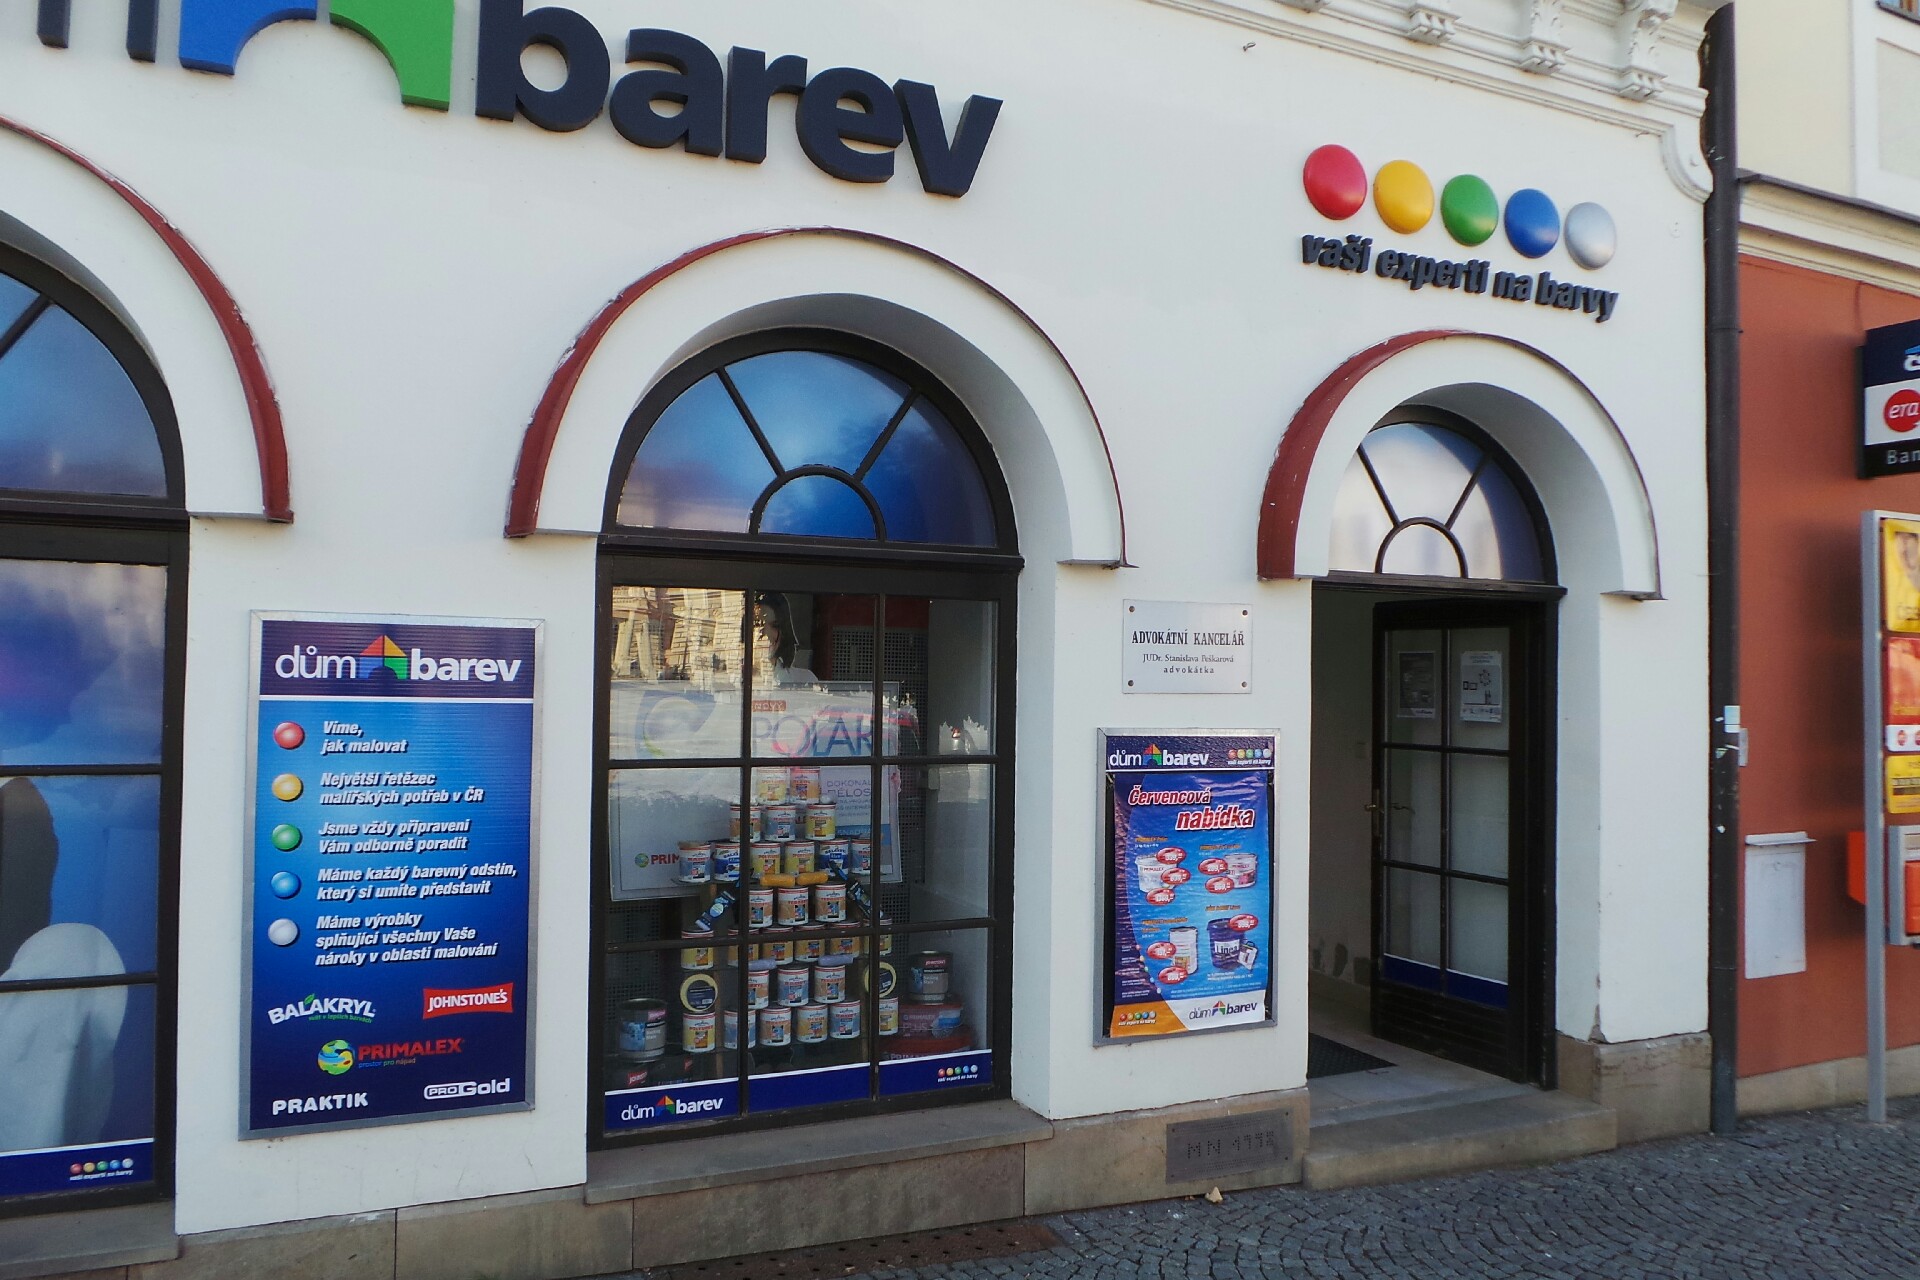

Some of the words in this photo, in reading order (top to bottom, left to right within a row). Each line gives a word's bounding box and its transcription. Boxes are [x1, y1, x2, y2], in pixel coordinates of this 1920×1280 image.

[476, 0, 1003, 198] barev
[1376, 248, 1490, 290] experti
[1492, 270, 1534, 301] na
[1535, 271, 1619, 323] barvy
[1888, 402, 1919, 418] era
[1132, 629, 1188, 645] ADVOKÁTNÍ
[1194, 630, 1245, 646] KANCELÁŘ
[275, 645, 356, 679] dům
[410, 649, 521, 682] barev
[1143, 653, 1163, 663] JUDr.
[1165, 653, 1199, 663] Stanislava
[1163, 665, 1214, 674] advokátka
[320, 739, 346, 755] jak
[348, 739, 407, 753] malovat
[1109, 750, 1142, 766] dům
[1163, 750, 1210, 766] barev
[382, 770, 436, 786] řetězec
[402, 788, 449, 804] potřeb
[453, 791, 461, 802] v
[464, 785, 484, 802] ČR
[1129, 785, 1212, 805] Červencová
[1175, 805, 1256, 831] nabídka
[318, 822, 358, 835] Jsme
[362, 820, 396, 836] vždy
[319, 839, 351, 853] Vám
[353, 837, 414, 852] odborně
[415, 837, 468, 853] poradit
[317, 867, 362, 882] Máme
[365, 865, 409, 882] každý
[411, 863, 467, 880] barevný
[316, 885, 357, 902] který
[358, 884, 374, 899] si
[375, 882, 417, 898] umíte
[420, 880, 491, 899] představit
[316, 915, 360, 929] Máme
[364, 912, 422, 929] výrobky
[315, 931, 380, 949] splňující
[382, 929, 440, 945] všechny
[444, 927, 476, 941] Vaše
[315, 950, 366, 966] nároky
[369, 950, 379, 963] v
[382, 946, 432, 962] oblasti
[434, 942, 498, 959] malování
[427, 988, 508, 1012] JOHNSTONE'S
[267, 997, 376, 1025] BALAKRYL
[1189, 1006, 1212, 1020] dům
[1226, 1002, 1258, 1015] barev
[358, 1037, 463, 1061] PRIMALEX
[272, 1091, 369, 1116] PRAKTIK
[621, 1104, 655, 1121] dům
[676, 1097, 724, 1115] barev
